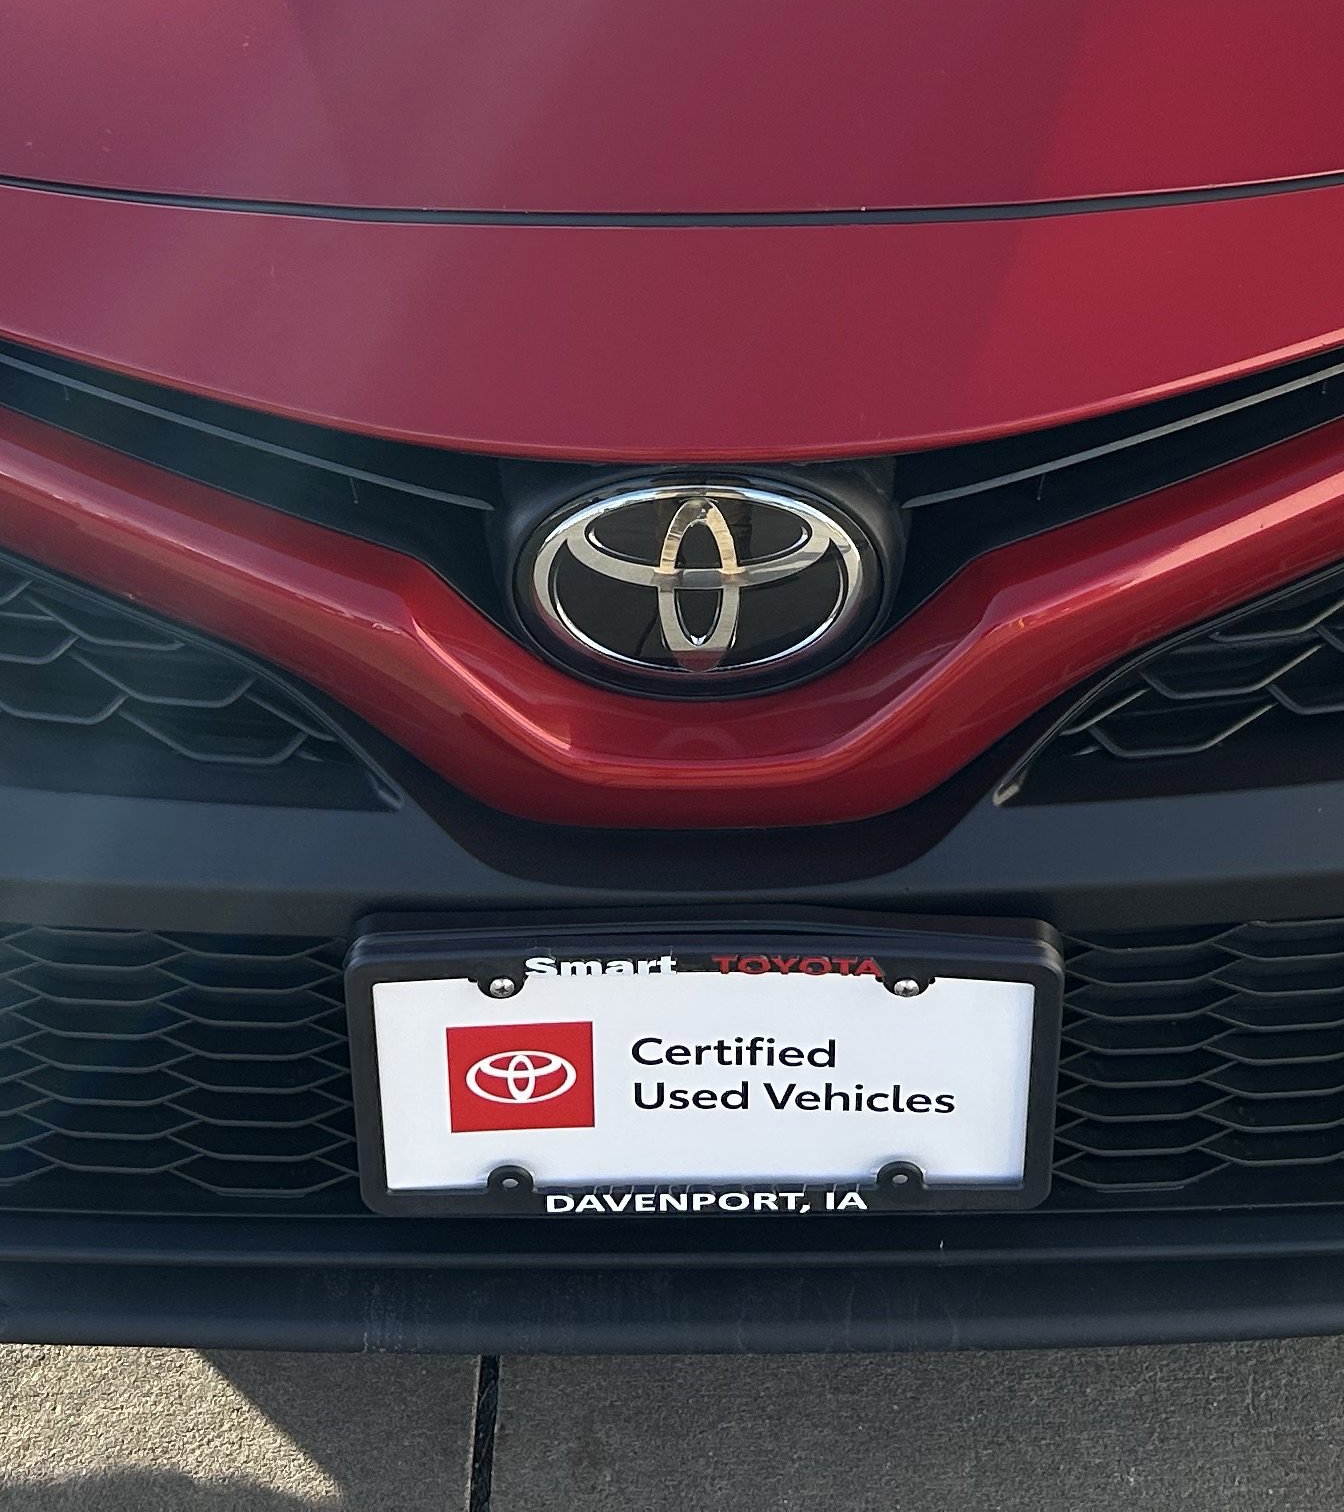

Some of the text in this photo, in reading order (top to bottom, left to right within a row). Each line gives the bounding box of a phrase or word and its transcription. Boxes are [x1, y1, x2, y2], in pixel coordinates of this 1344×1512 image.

[524, 954, 885, 979] Smart TOYOTA
[631, 1036, 836, 1068] Certified
[634, 1080, 956, 1114] Used Vehicles
[545, 1191, 869, 1214] DAVENPORT, IA
